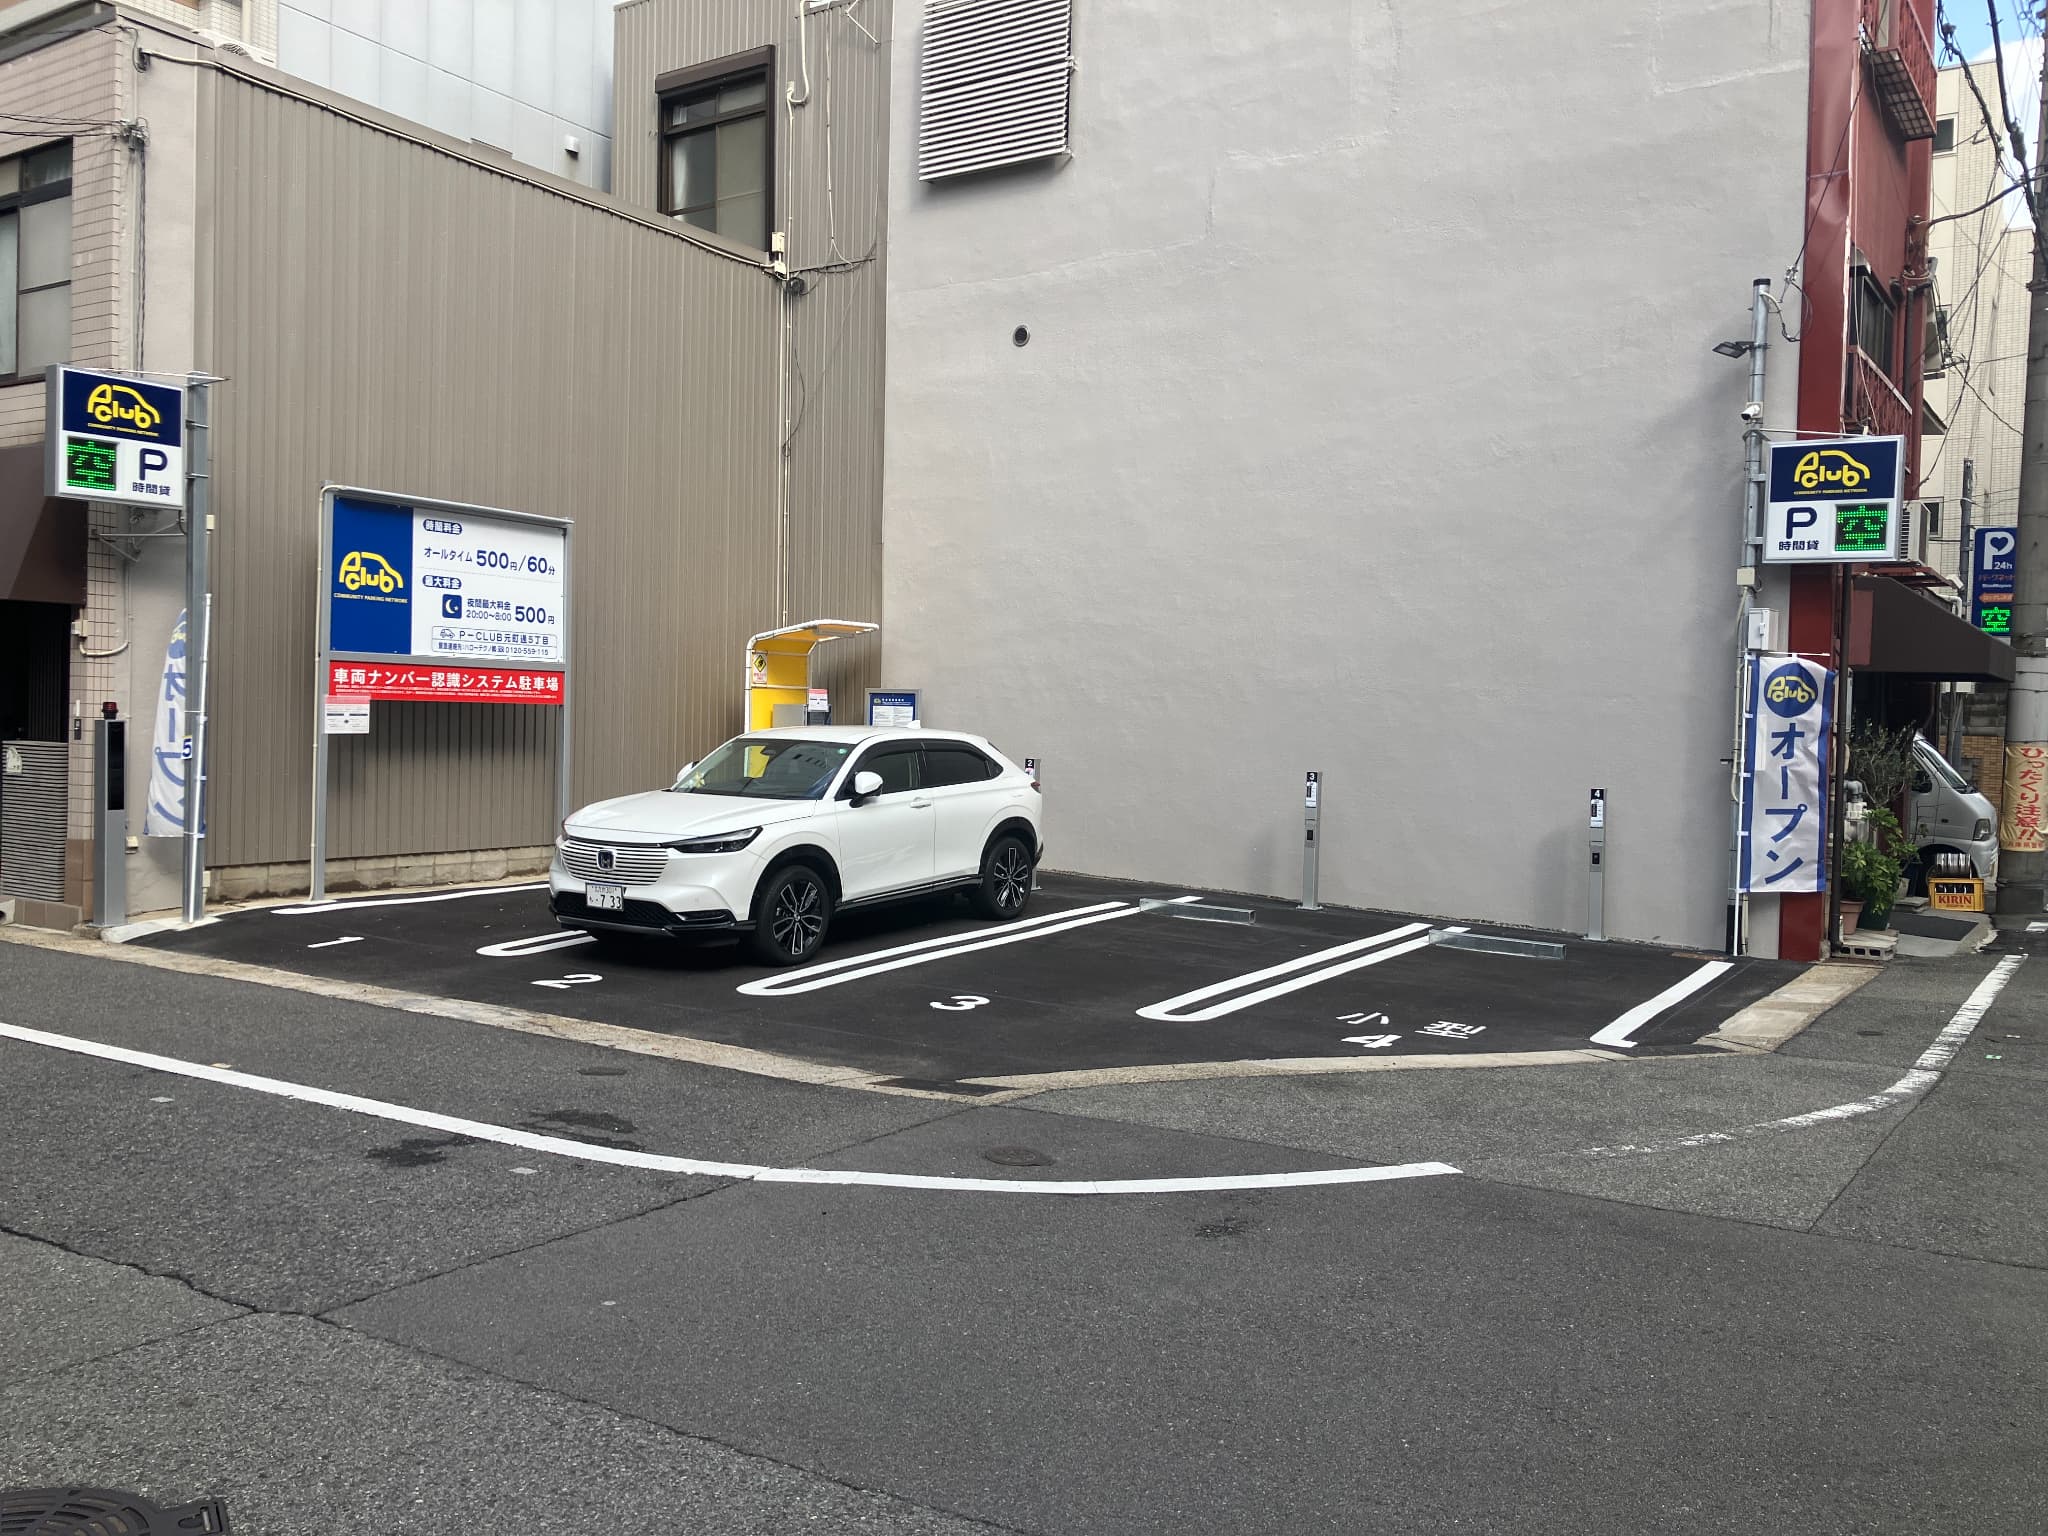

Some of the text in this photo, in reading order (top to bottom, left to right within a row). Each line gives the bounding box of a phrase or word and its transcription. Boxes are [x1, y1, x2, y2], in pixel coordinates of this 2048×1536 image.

[66, 441, 116, 491] 空
[139, 448, 168, 481] P
[132, 482, 171, 496] 時間貸
[1786, 507, 1817, 539] P
[1835, 505, 1887, 551] 空
[1778, 540, 1819, 551] 時間貸
[1983, 531, 2015, 570] P
[424, 547, 473, 563] オールタイム
[1981, 606, 2011, 633] 空
[333, 668, 559, 692] 車両ナンバー認識システム駐車場
[1027, 759, 1033, 767] 2
[1594, 789, 1600, 798] 4
[1765, 723, 1808, 885] オープン
[1938, 895, 1972, 905] KIRIN
[307, 936, 365, 948] 1
[531, 973, 603, 989] 2
[929, 995, 991, 1011] 3
[1340, 1034, 1403, 1048] 4
